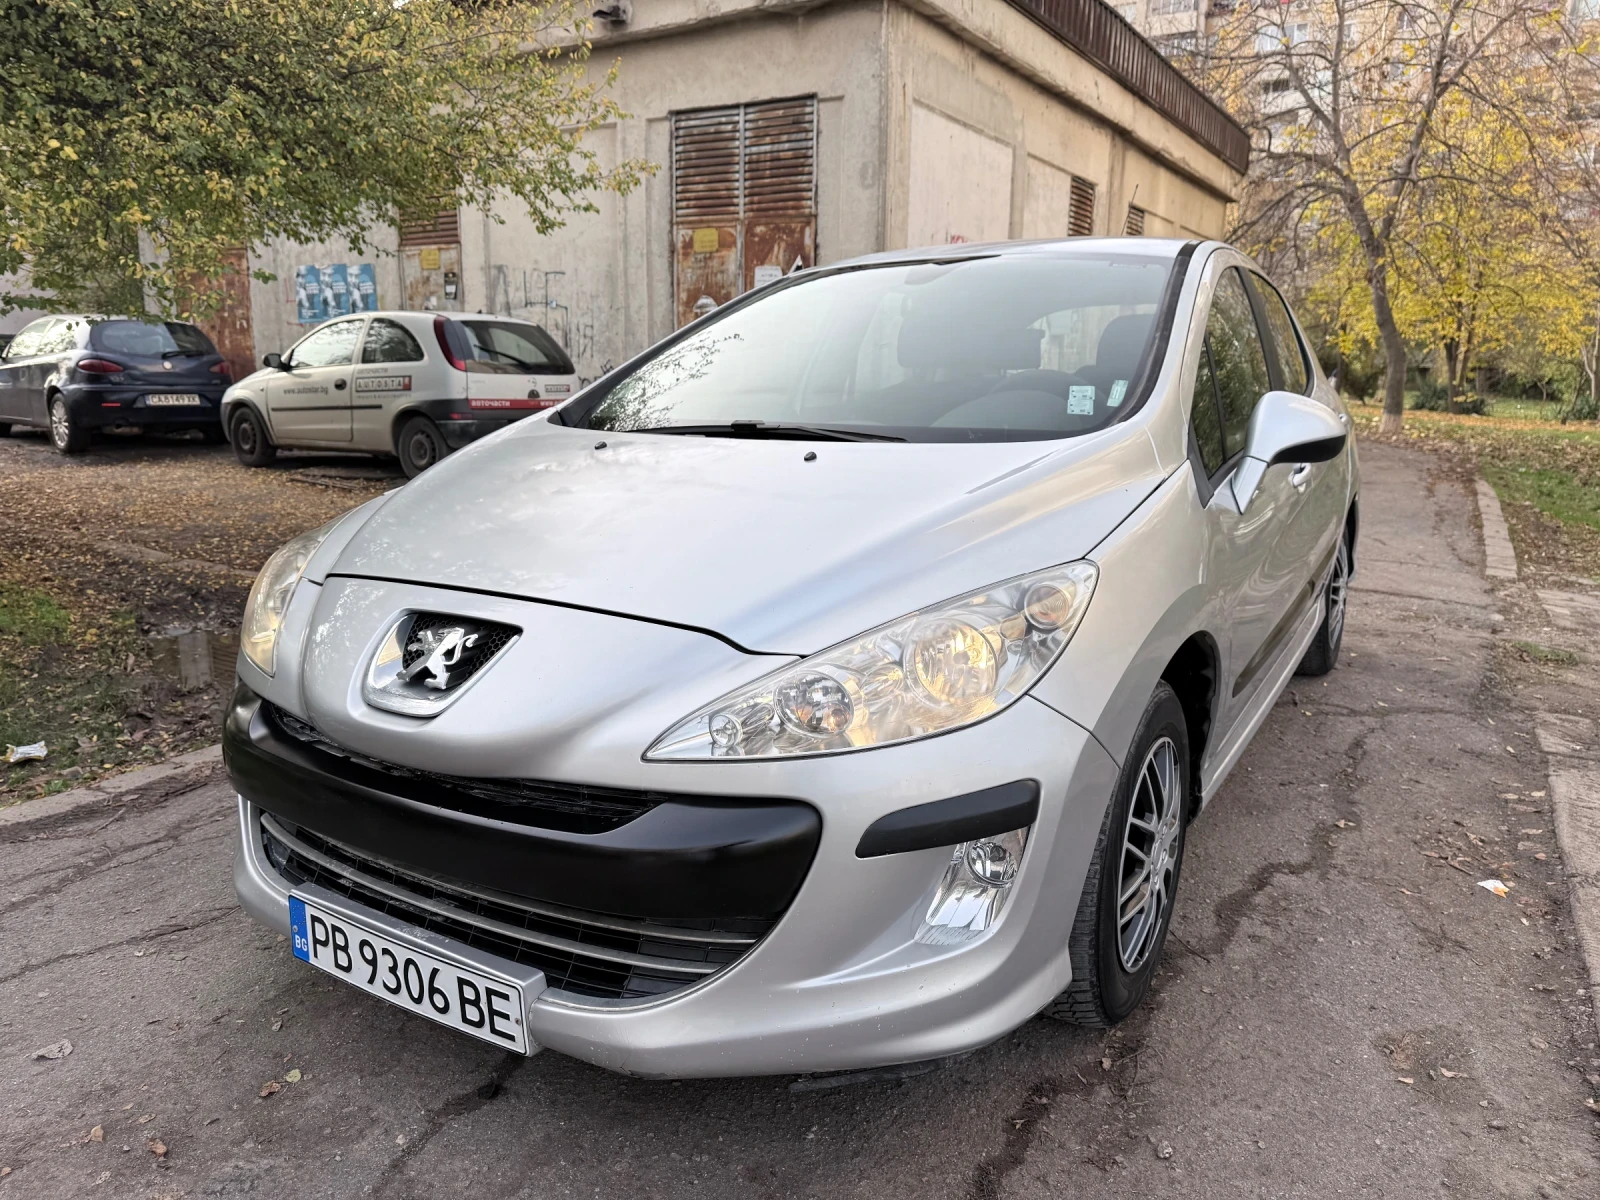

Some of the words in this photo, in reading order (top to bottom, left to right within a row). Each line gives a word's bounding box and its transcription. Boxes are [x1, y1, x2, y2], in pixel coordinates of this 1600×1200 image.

[294, 934, 308, 952] BG
[310, 913, 353, 973] PB
[358, 938, 451, 1015] 9306
[456, 975, 516, 1043] BE
